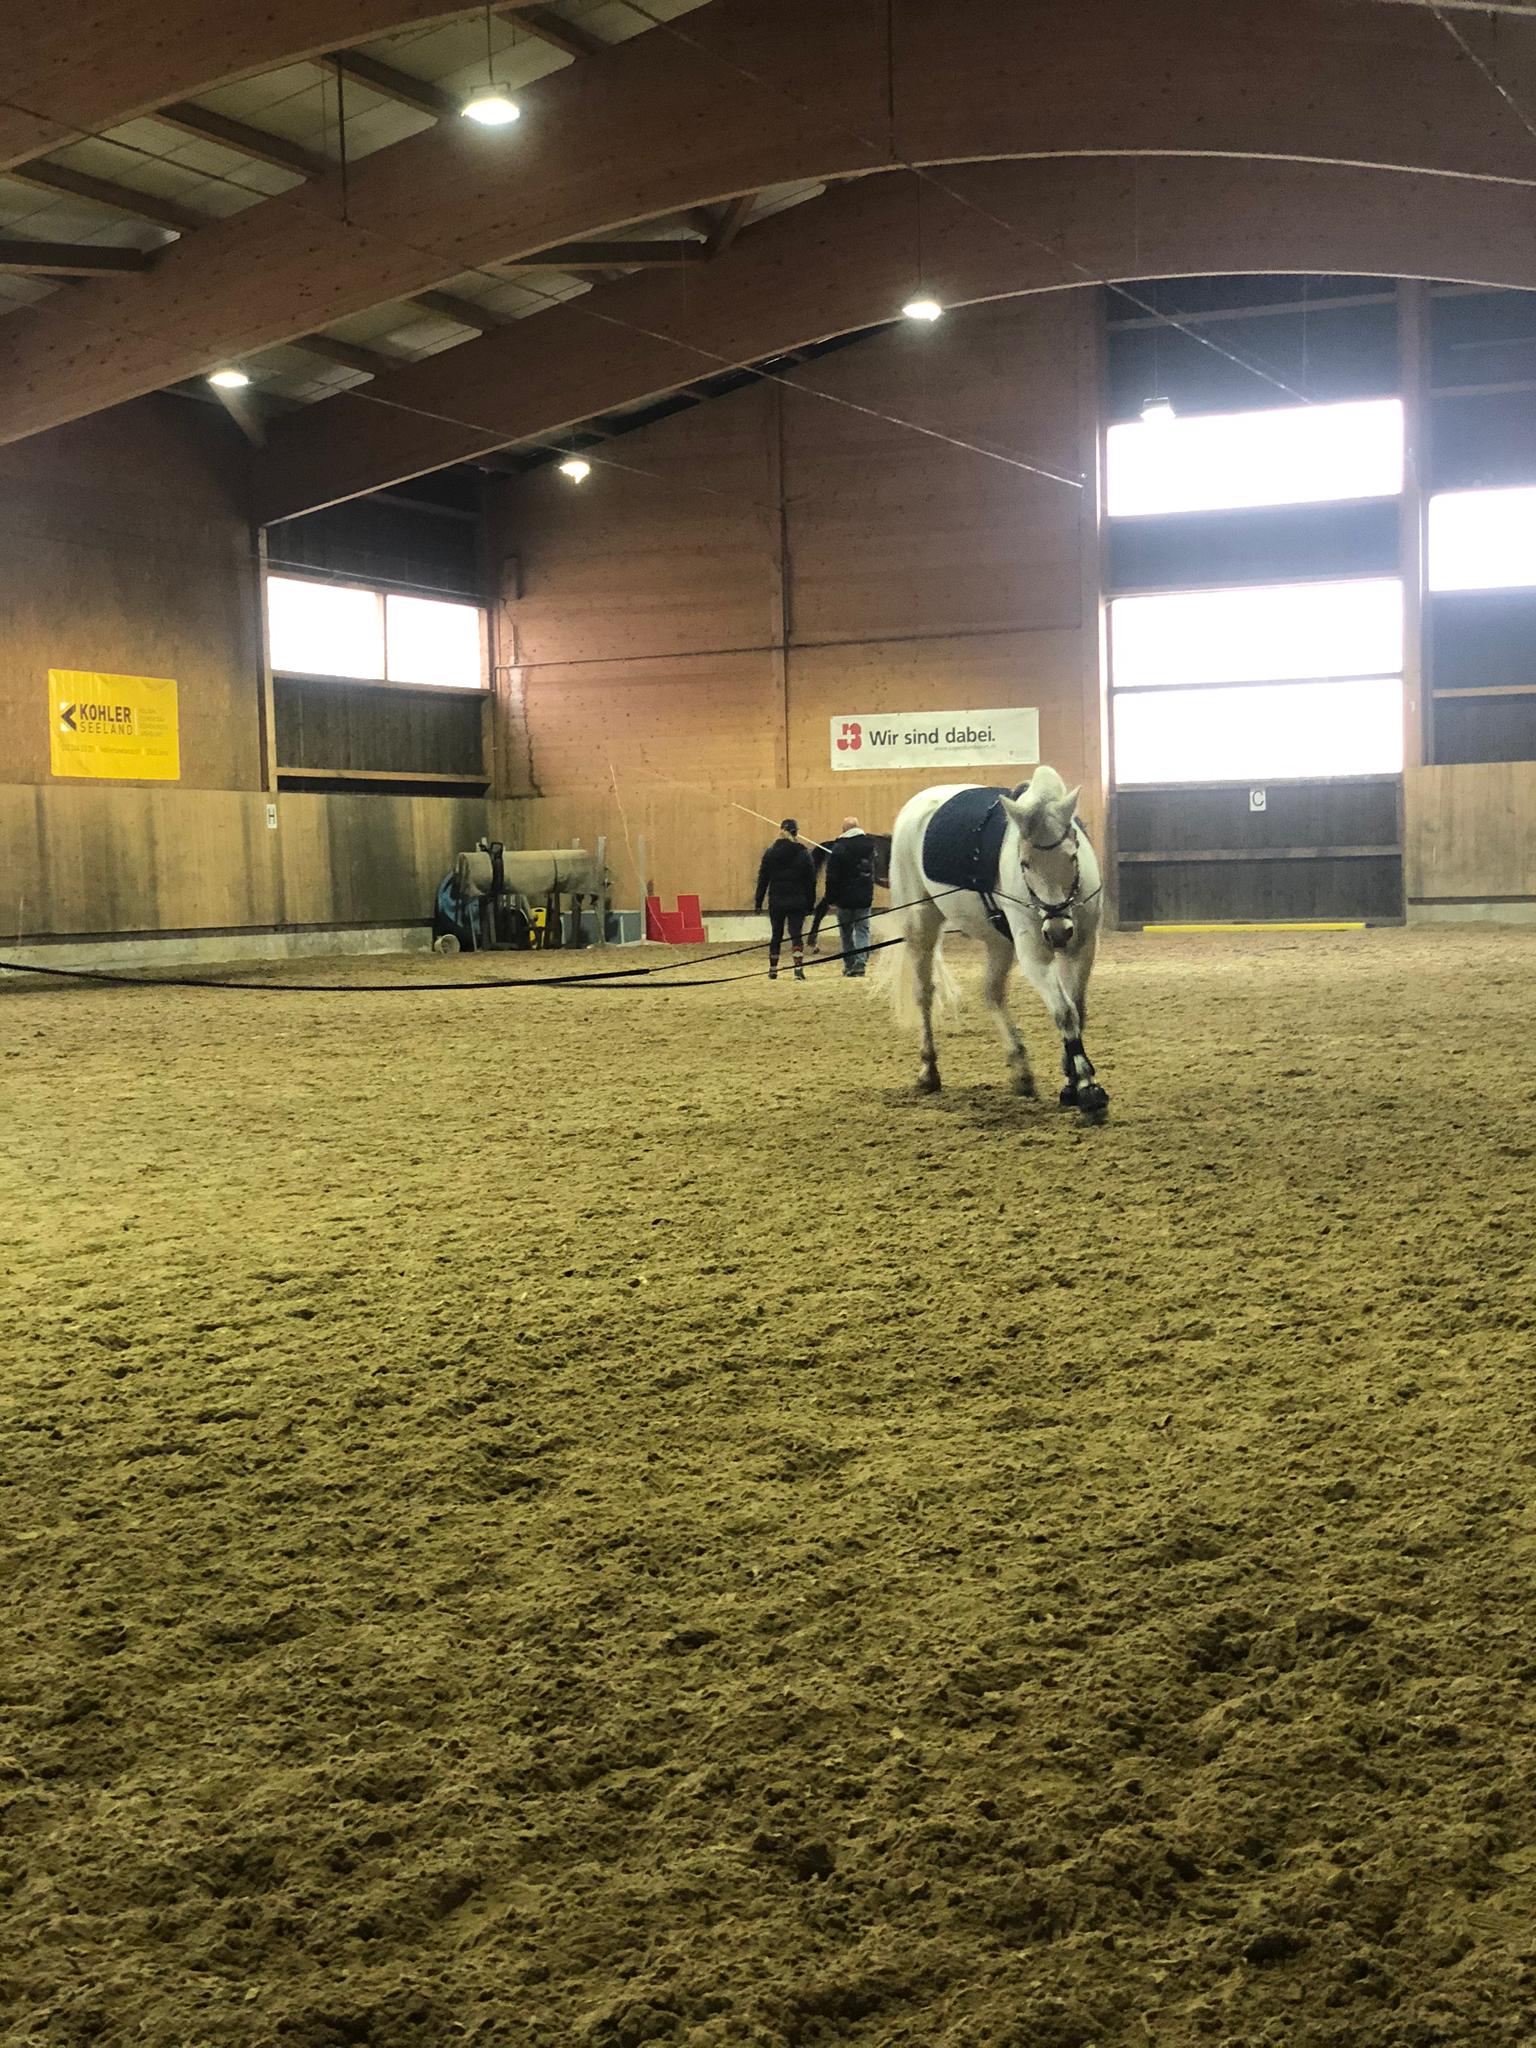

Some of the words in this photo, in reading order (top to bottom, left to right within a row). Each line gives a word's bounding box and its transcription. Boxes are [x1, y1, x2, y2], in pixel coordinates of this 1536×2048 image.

[80, 703, 132, 723] KOHLER
[80, 722, 133, 735] SEELAND
[869, 730, 899, 746] Wir
[904, 727, 939, 745] sind
[945, 725, 996, 743] dabei.
[1252, 790, 1264, 807] C
[268, 807, 276, 825] H
